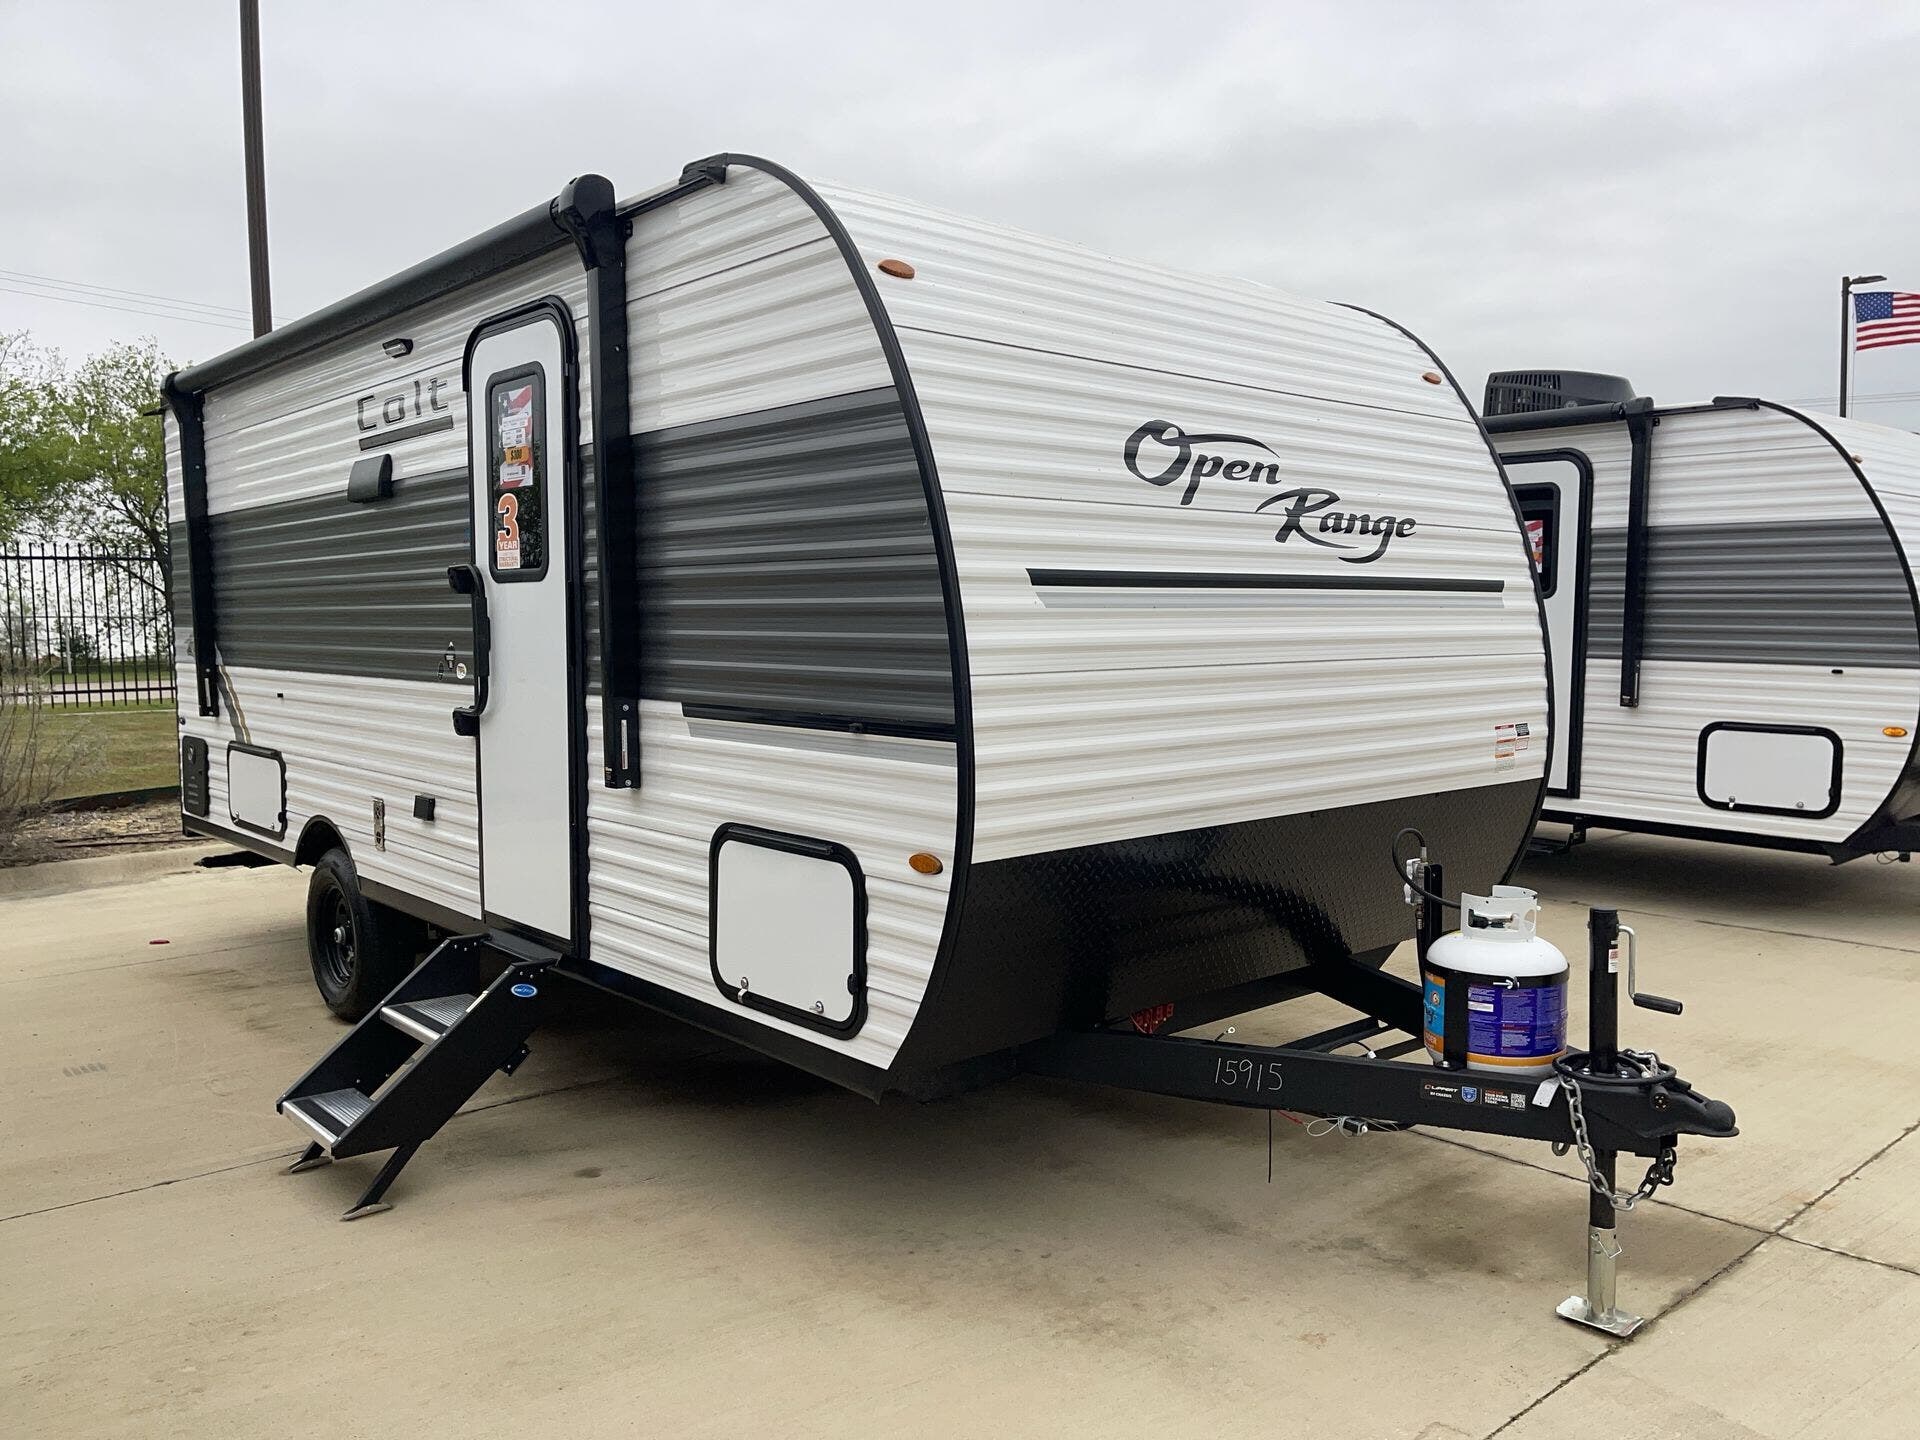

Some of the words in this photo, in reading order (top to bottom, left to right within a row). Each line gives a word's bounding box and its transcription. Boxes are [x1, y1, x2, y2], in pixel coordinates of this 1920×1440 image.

[358, 378, 449, 431] Colt
[1124, 419, 1282, 505] Open
[498, 493, 519, 541] 3
[1255, 487, 1417, 564] Range
[499, 541, 518, 550] YEAR
[1215, 1057, 1283, 1092] 15915
